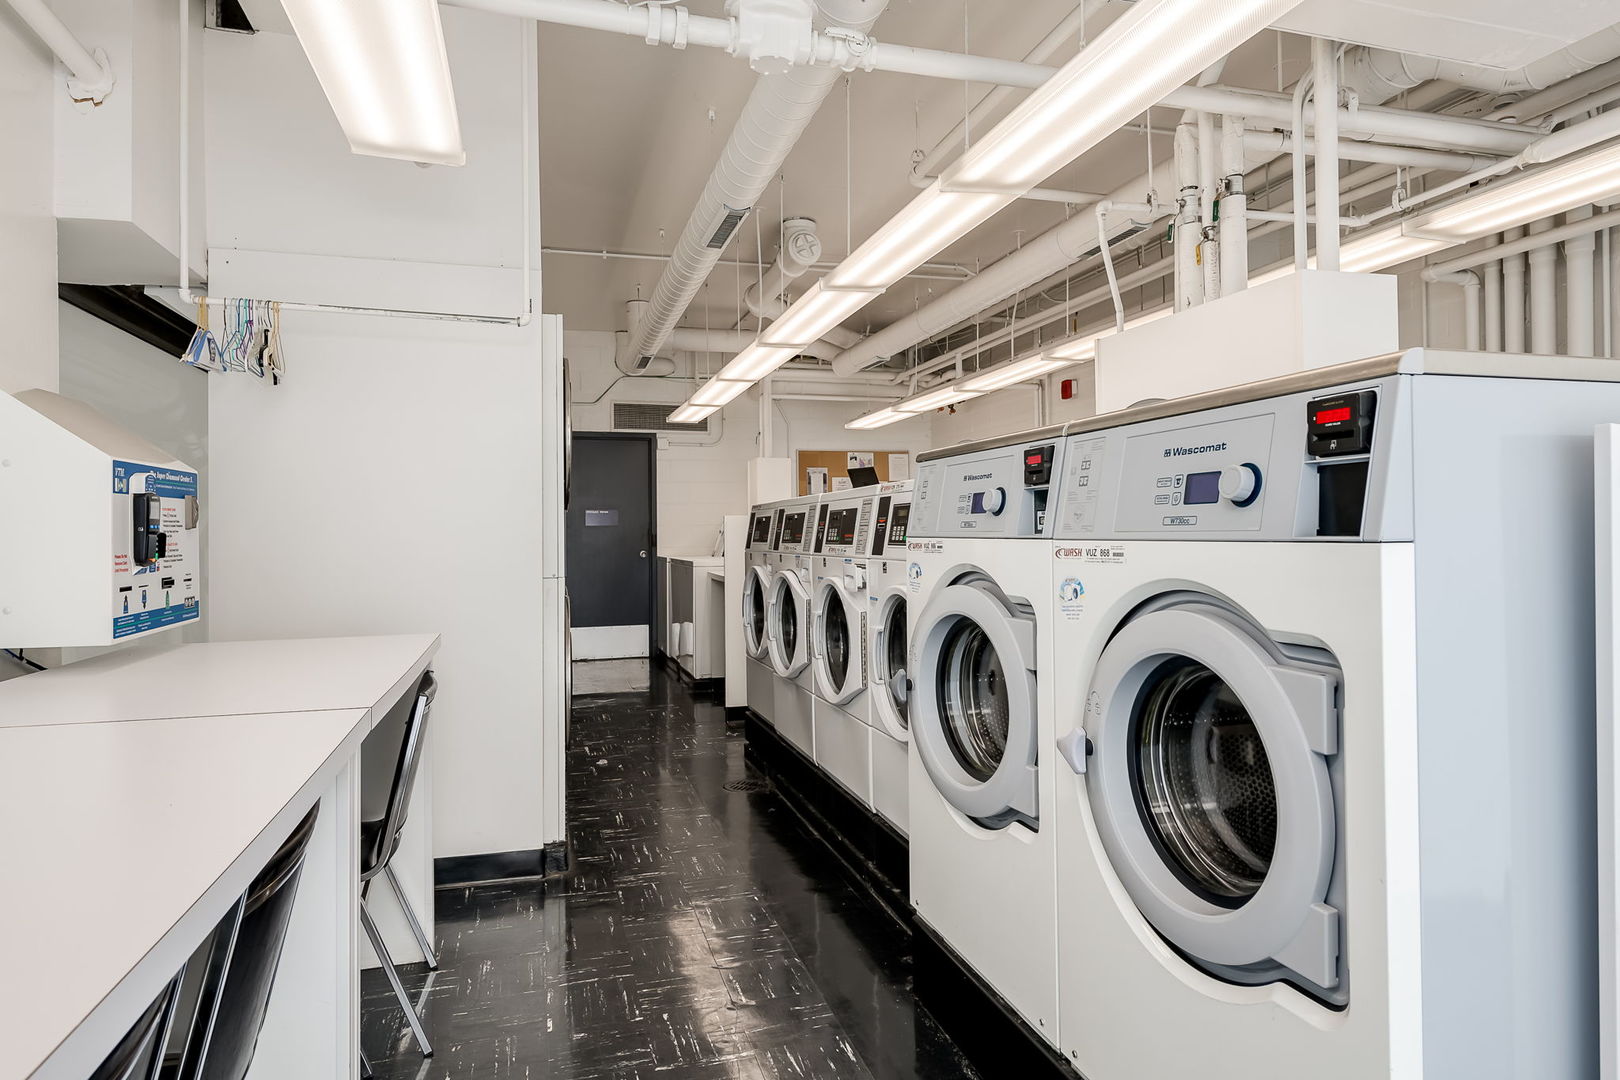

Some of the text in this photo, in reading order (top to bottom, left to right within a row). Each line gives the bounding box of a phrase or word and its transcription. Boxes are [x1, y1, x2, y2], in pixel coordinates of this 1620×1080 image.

[1172, 442, 1227, 456] Wascomat
[968, 472, 992, 480] Wascomat
[1063, 548, 1082, 557] WASH
[1100, 549, 1110, 557] 868
